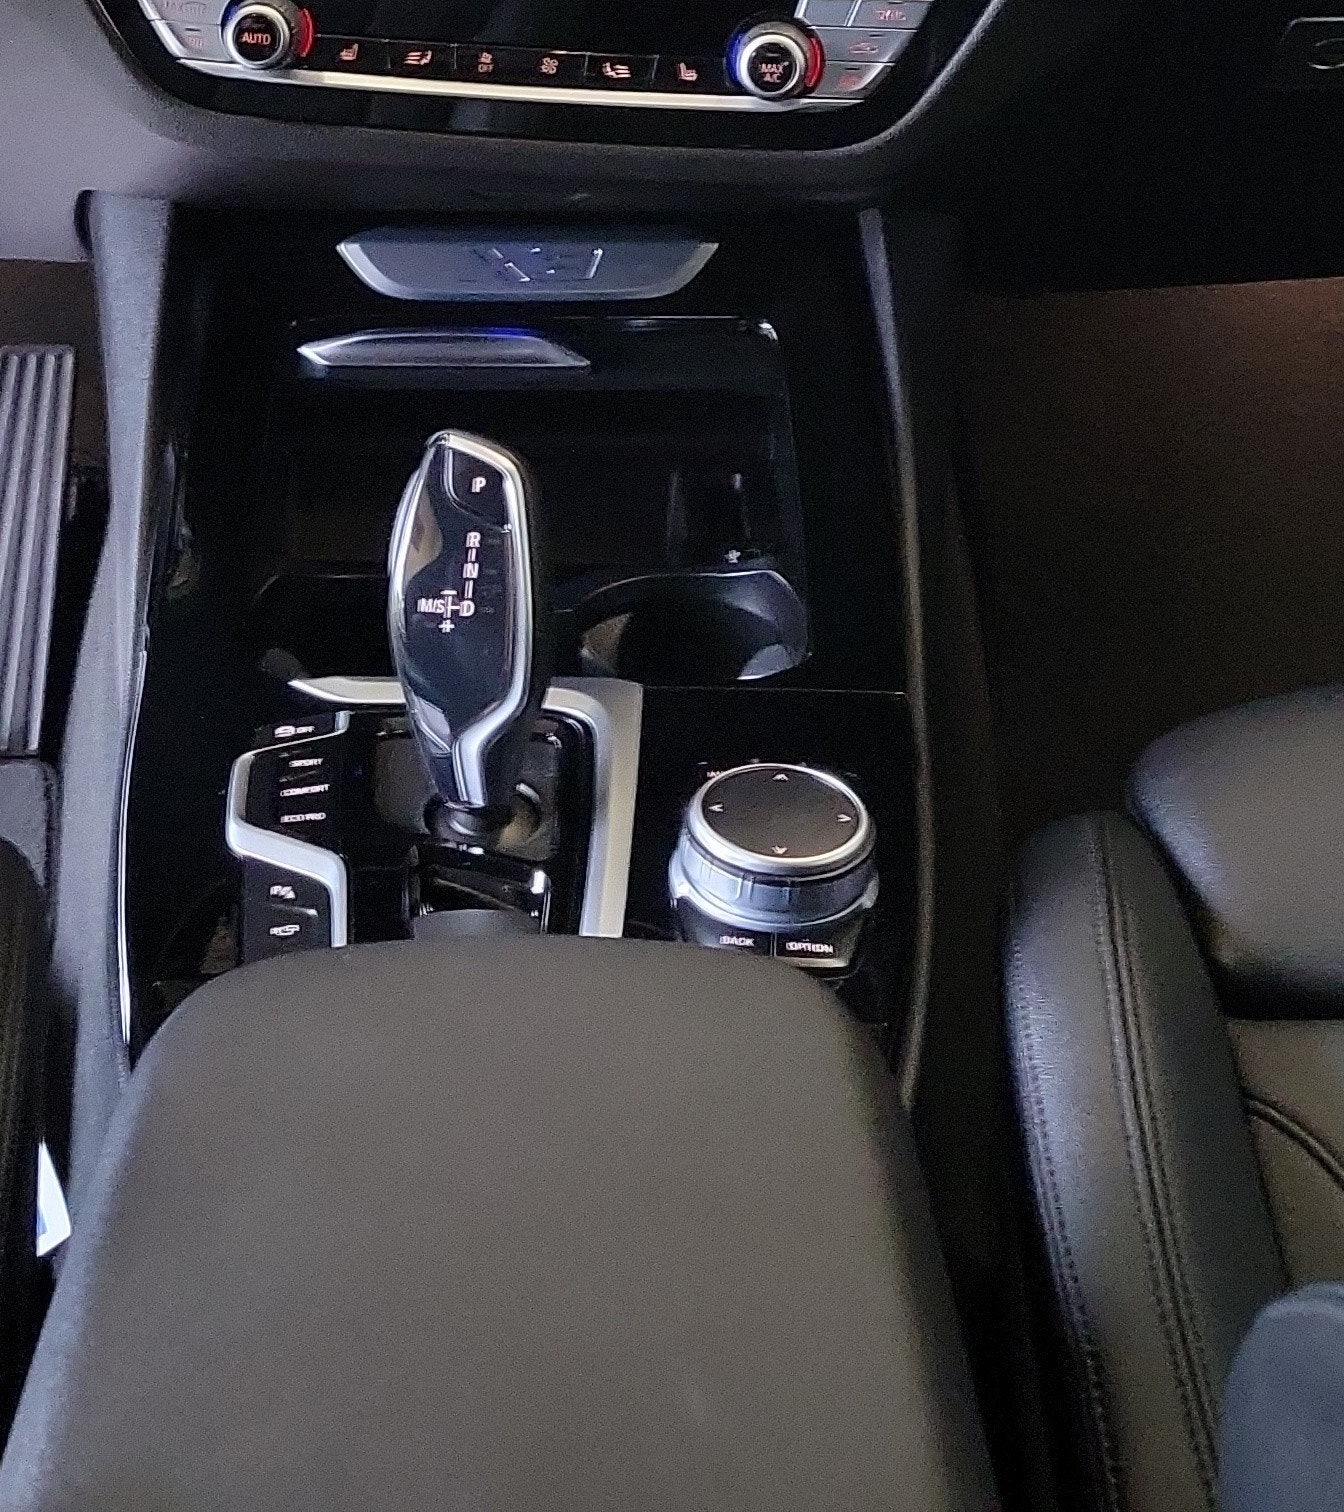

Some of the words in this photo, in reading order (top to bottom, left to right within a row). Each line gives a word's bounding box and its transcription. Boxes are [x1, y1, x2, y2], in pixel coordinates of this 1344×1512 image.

[241, 32, 272, 46] AUTO
[471, 475, 487, 494] P
[465, 531, 482, 548] R
[462, 562, 480, 579] N
[785, 941, 834, 954] OPTION
